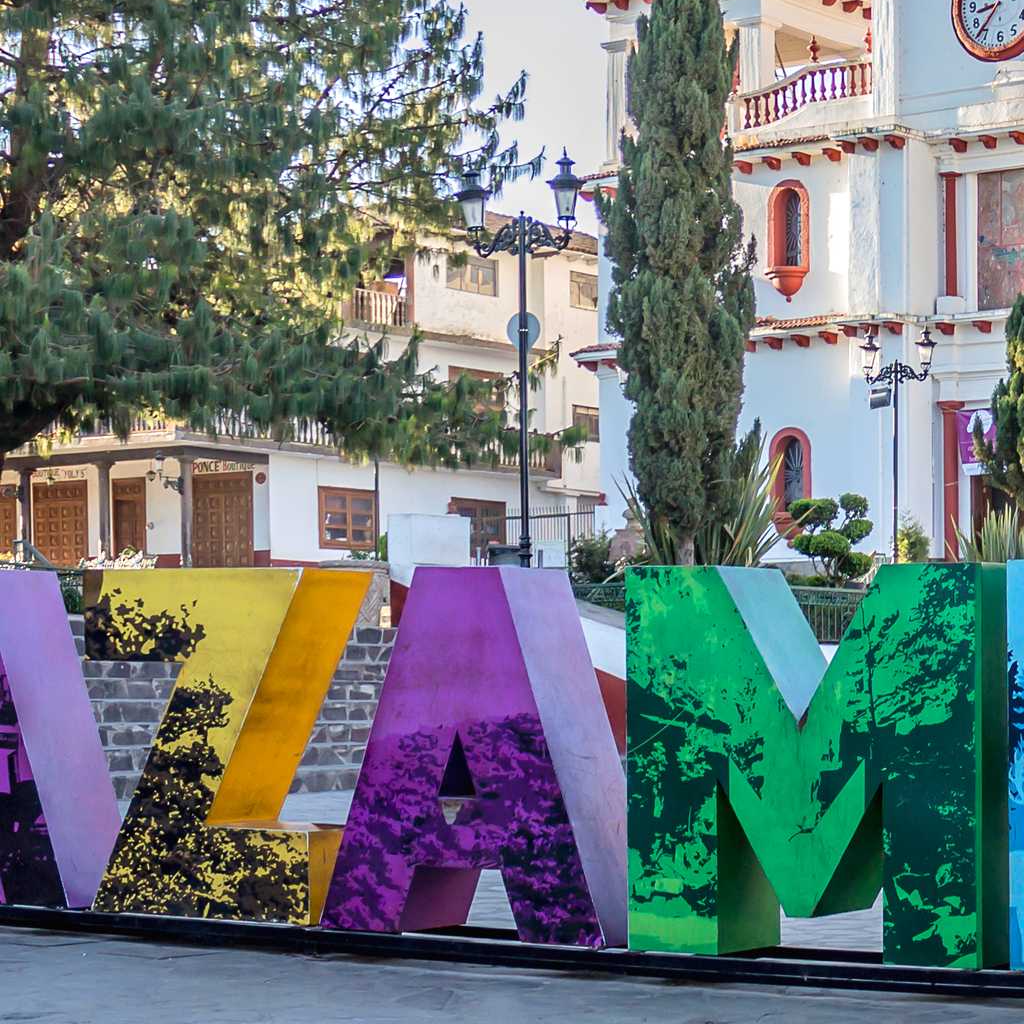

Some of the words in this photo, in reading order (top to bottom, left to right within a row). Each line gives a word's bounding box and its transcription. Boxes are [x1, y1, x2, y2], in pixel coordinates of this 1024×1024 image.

[969, 1, 976, 13] 9
[1019, 9, 1024, 20] 4
[973, 17, 980, 29] 8
[981, 28, 989, 40] 7
[1010, 24, 1017, 36] 5
[996, 31, 1004, 42] 6
[192, 461, 220, 473] PONCE
